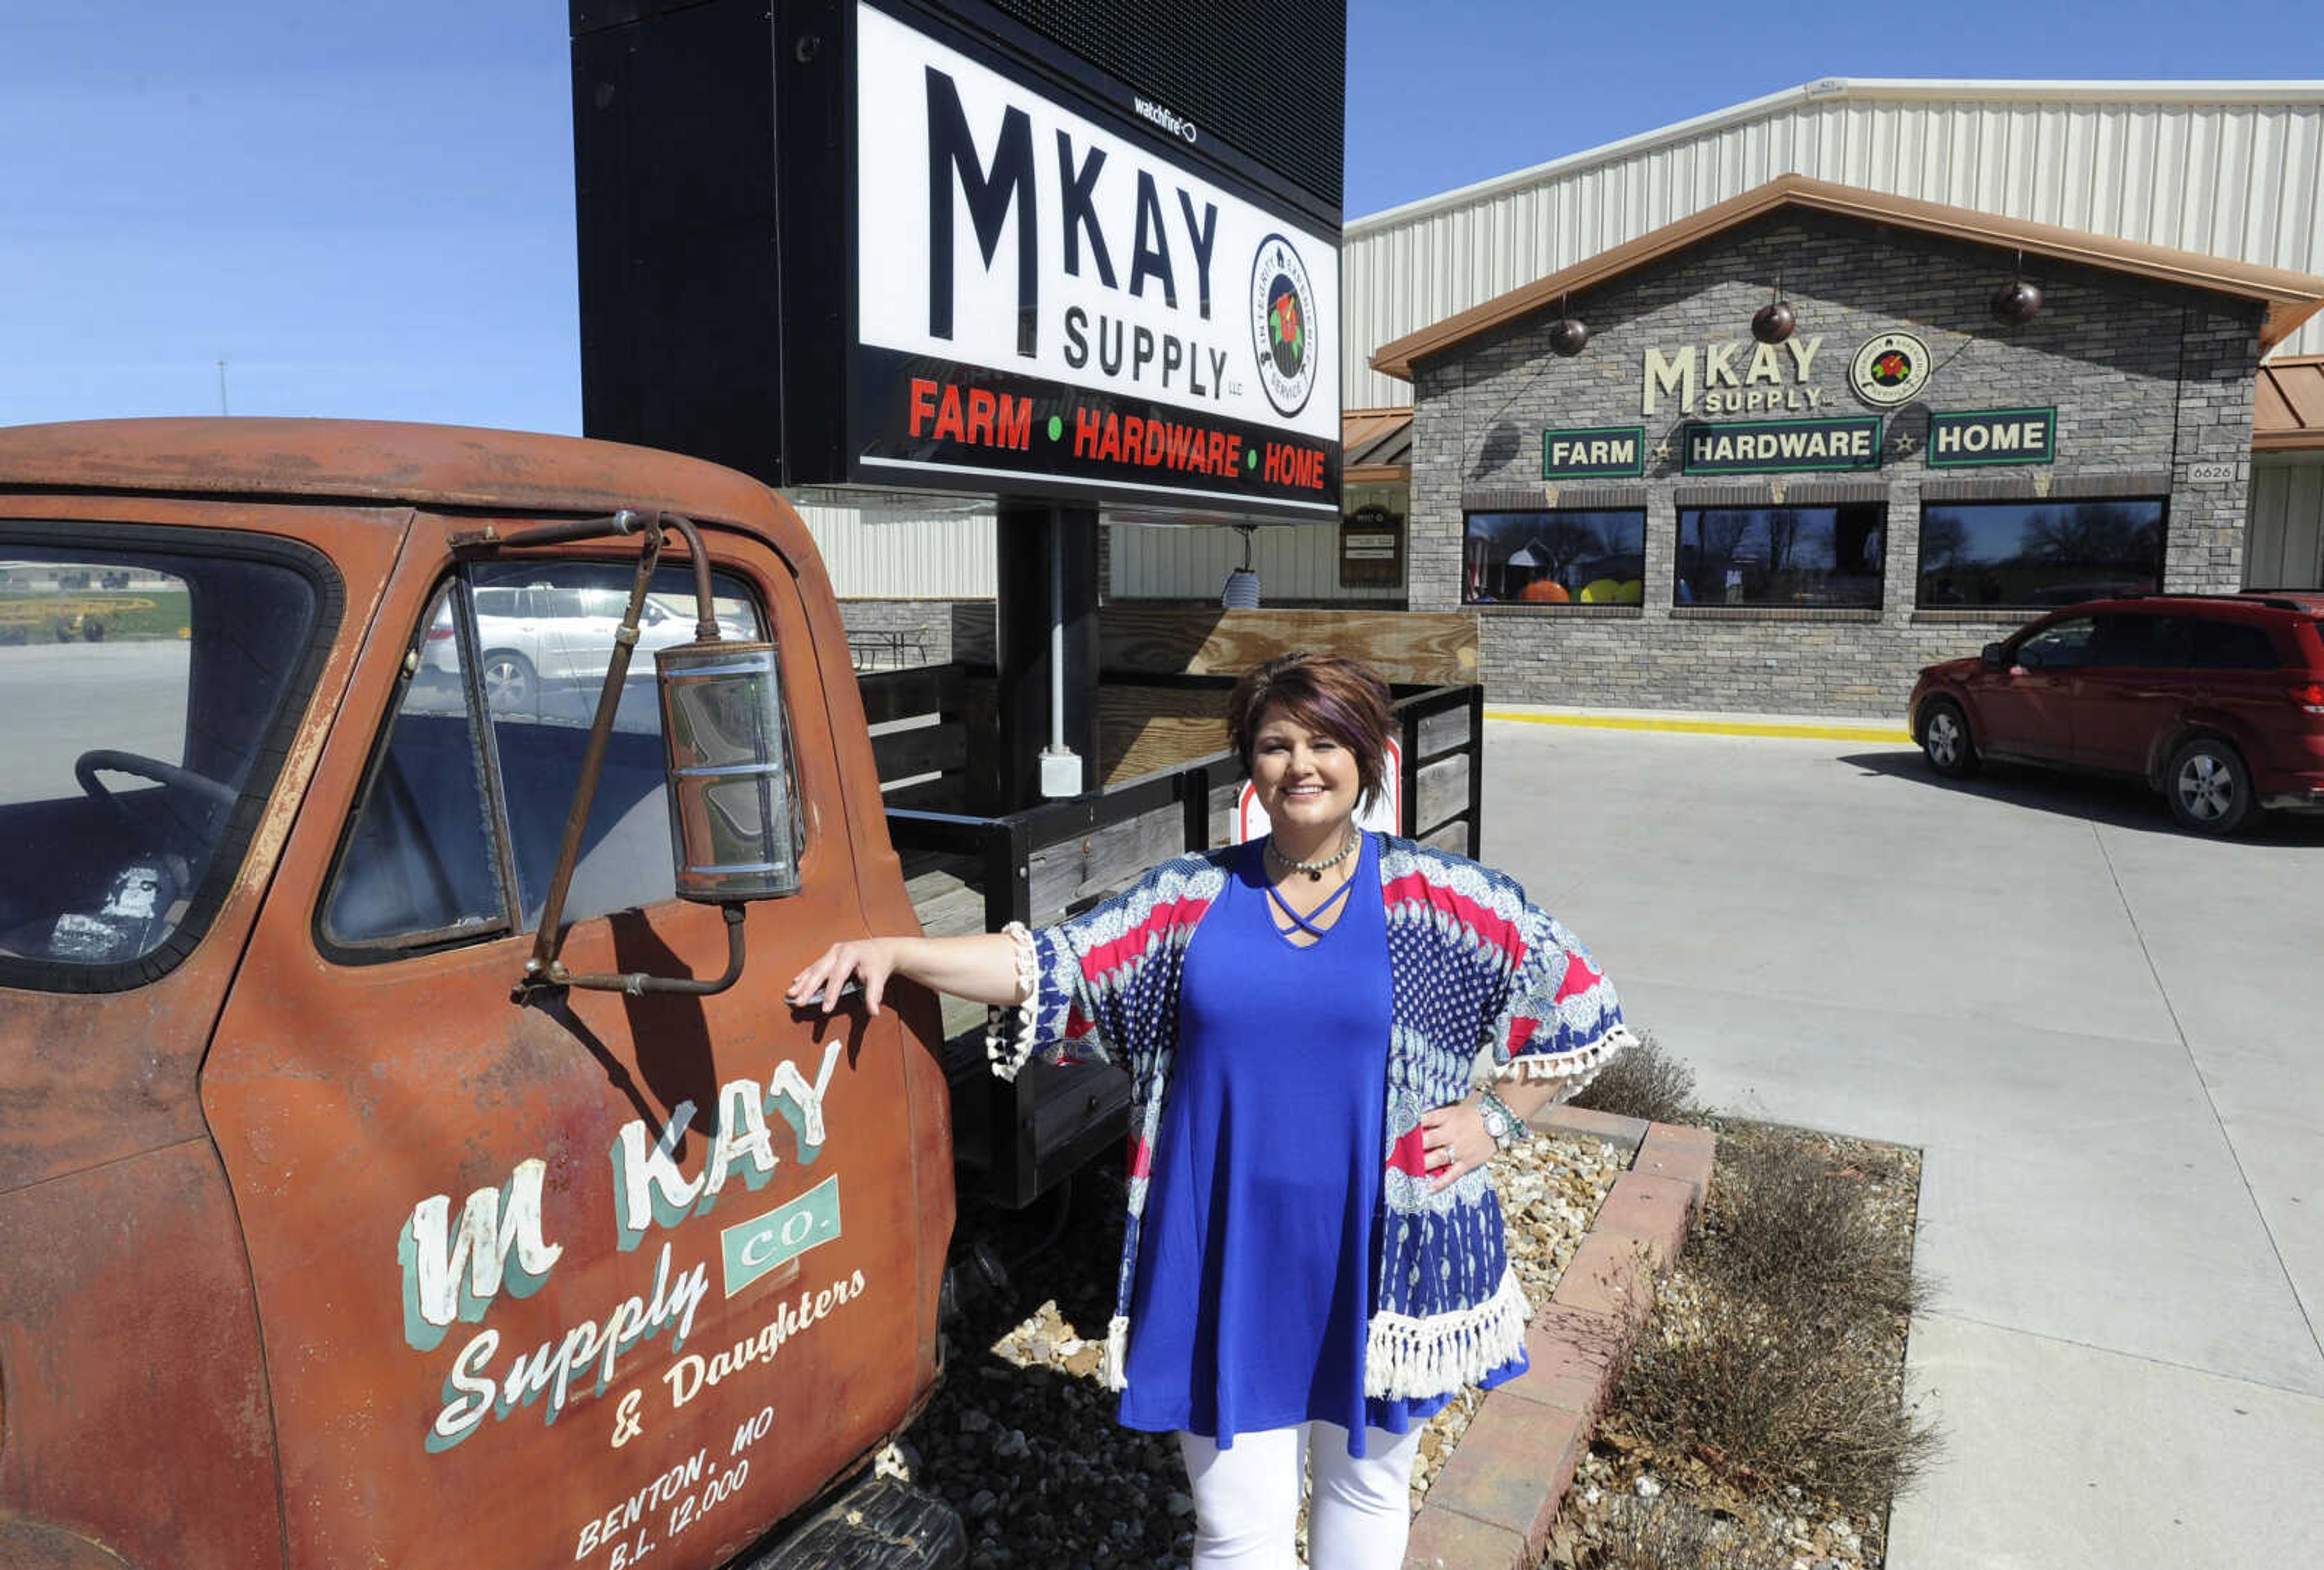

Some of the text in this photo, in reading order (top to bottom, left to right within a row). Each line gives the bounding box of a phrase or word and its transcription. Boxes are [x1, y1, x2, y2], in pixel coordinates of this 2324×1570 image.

[1134, 96, 1181, 136] watchfire
[925, 64, 1218, 358] MKAY
[1063, 306, 1227, 399] SUPPLY
[1643, 337, 1823, 415] MKAY
[1705, 387, 1822, 413] SUPPLY
[909, 378, 1324, 489] FARM HARDWARE HOME
[1552, 440, 1634, 465] FARM
[1693, 430, 1871, 461] HARDWARE
[1938, 422, 2045, 453] HOME
[2194, 466, 2231, 478] 6626
[740, 1210, 830, 1268] CO.
[435, 1241, 709, 1437] Supply
[611, 1269, 866, 1448] & Daughters
[730, 1406, 773, 1456] MO
[609, 1459, 749, 1570] B.L. 12,000
